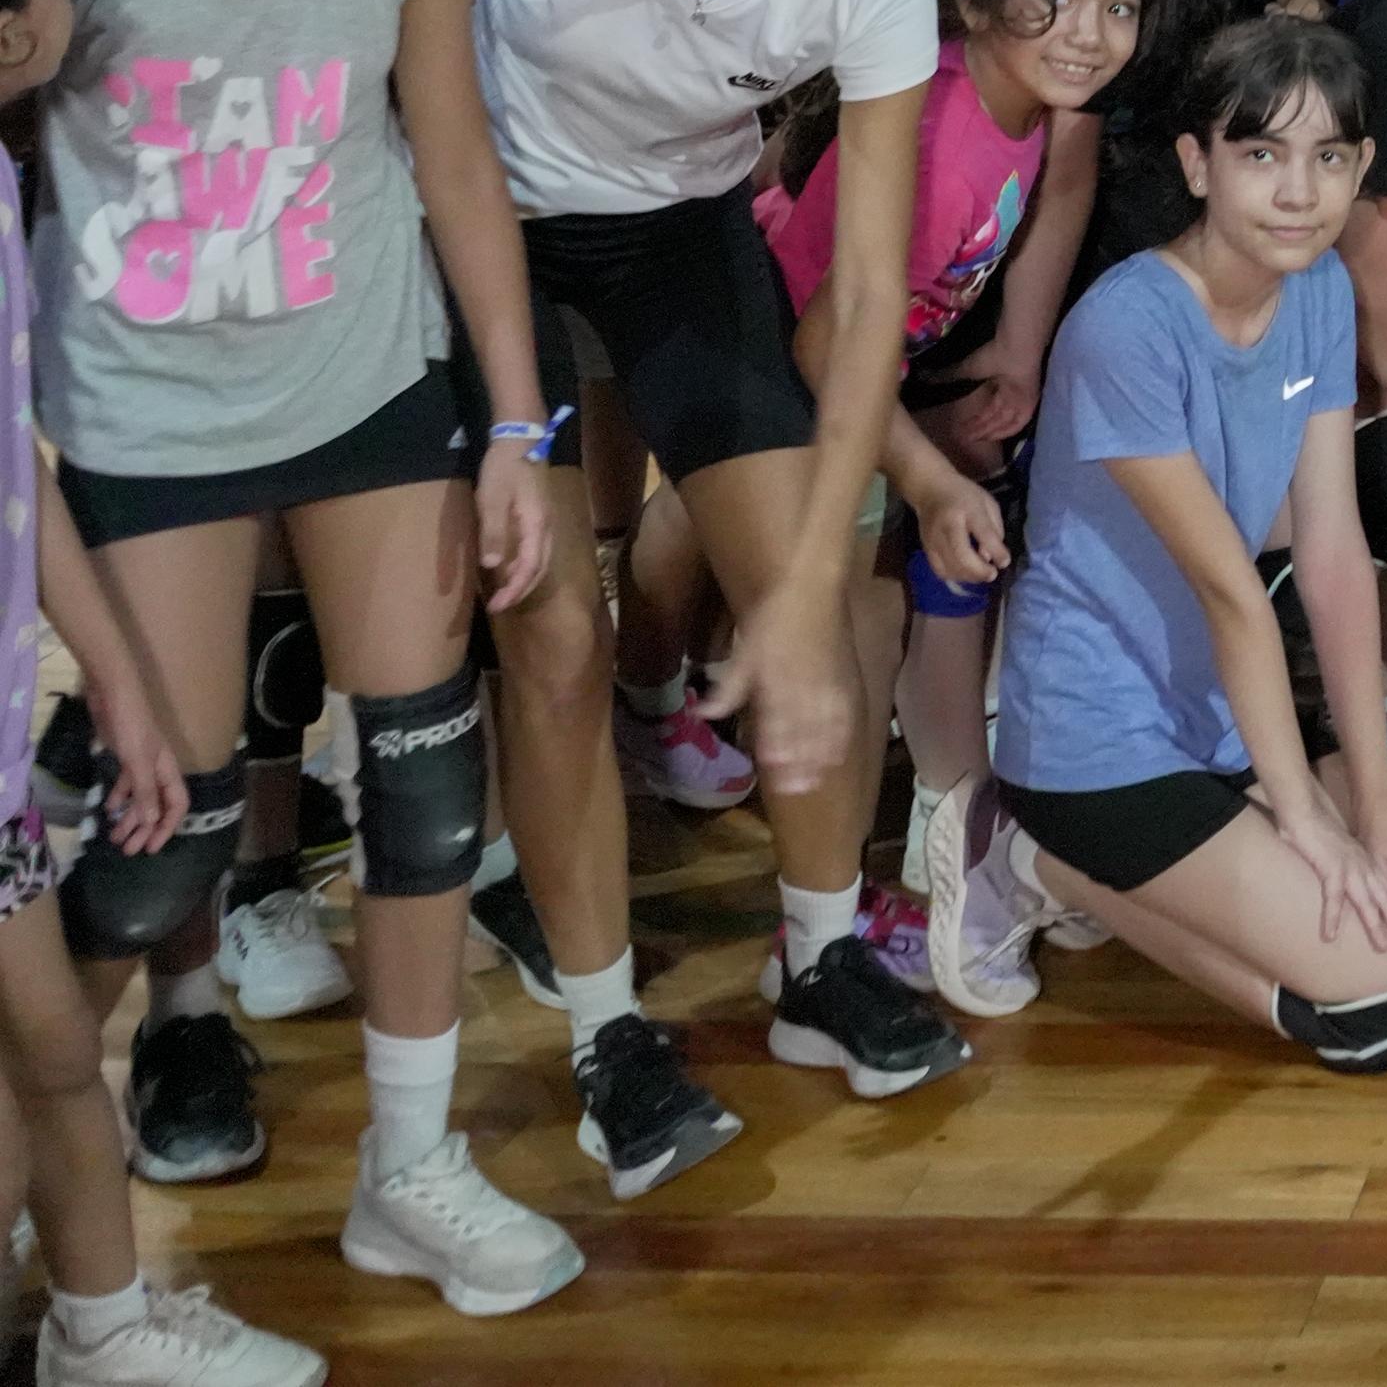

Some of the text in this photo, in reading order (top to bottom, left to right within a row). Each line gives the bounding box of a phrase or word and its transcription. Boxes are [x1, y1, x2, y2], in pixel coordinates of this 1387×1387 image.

[130, 57, 350, 154] I AM
[74, 200, 336, 325] SOME
